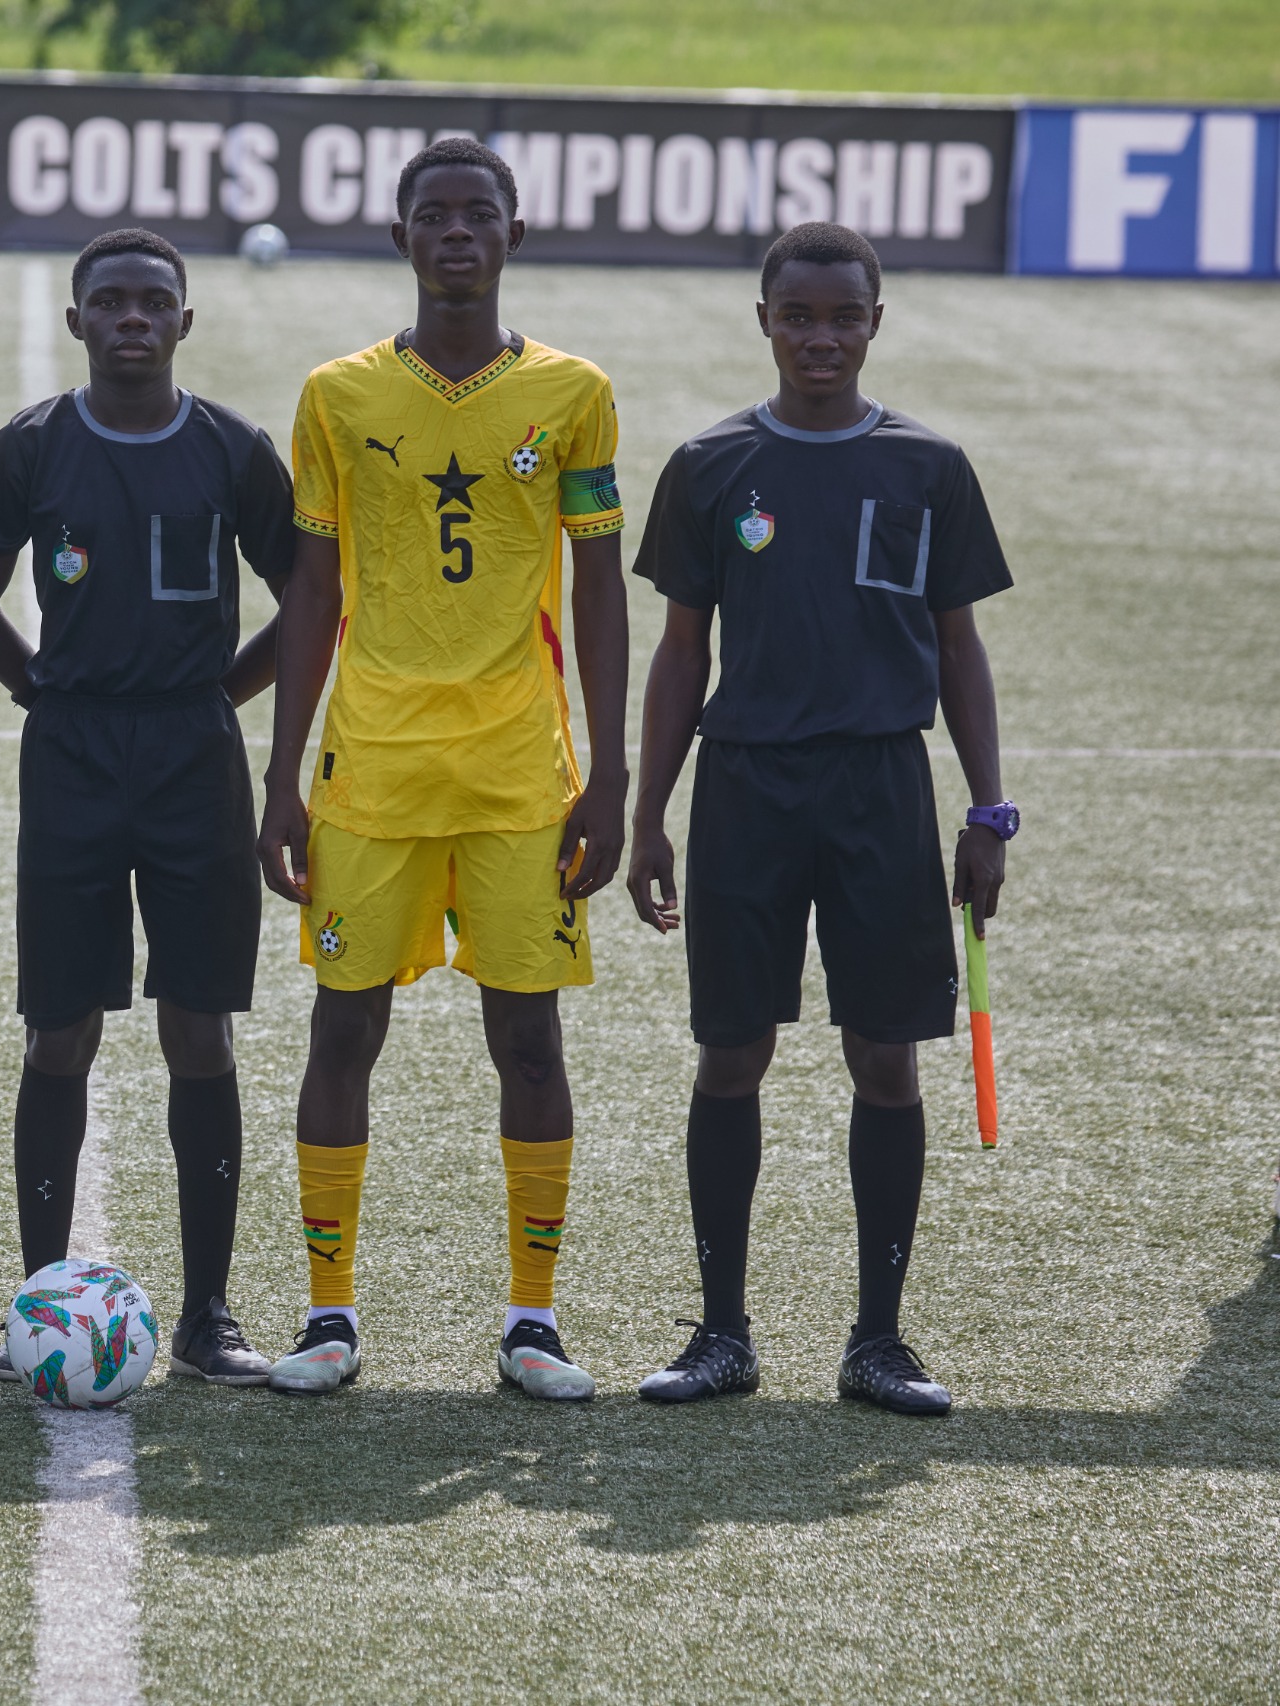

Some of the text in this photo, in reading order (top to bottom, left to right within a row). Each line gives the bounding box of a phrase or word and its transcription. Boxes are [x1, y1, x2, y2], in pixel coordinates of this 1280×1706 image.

[7, 115, 994, 241] COLTS CHMPIONSHIP
[1067, 111, 1280, 273] FI
[439, 512, 474, 583] 5
